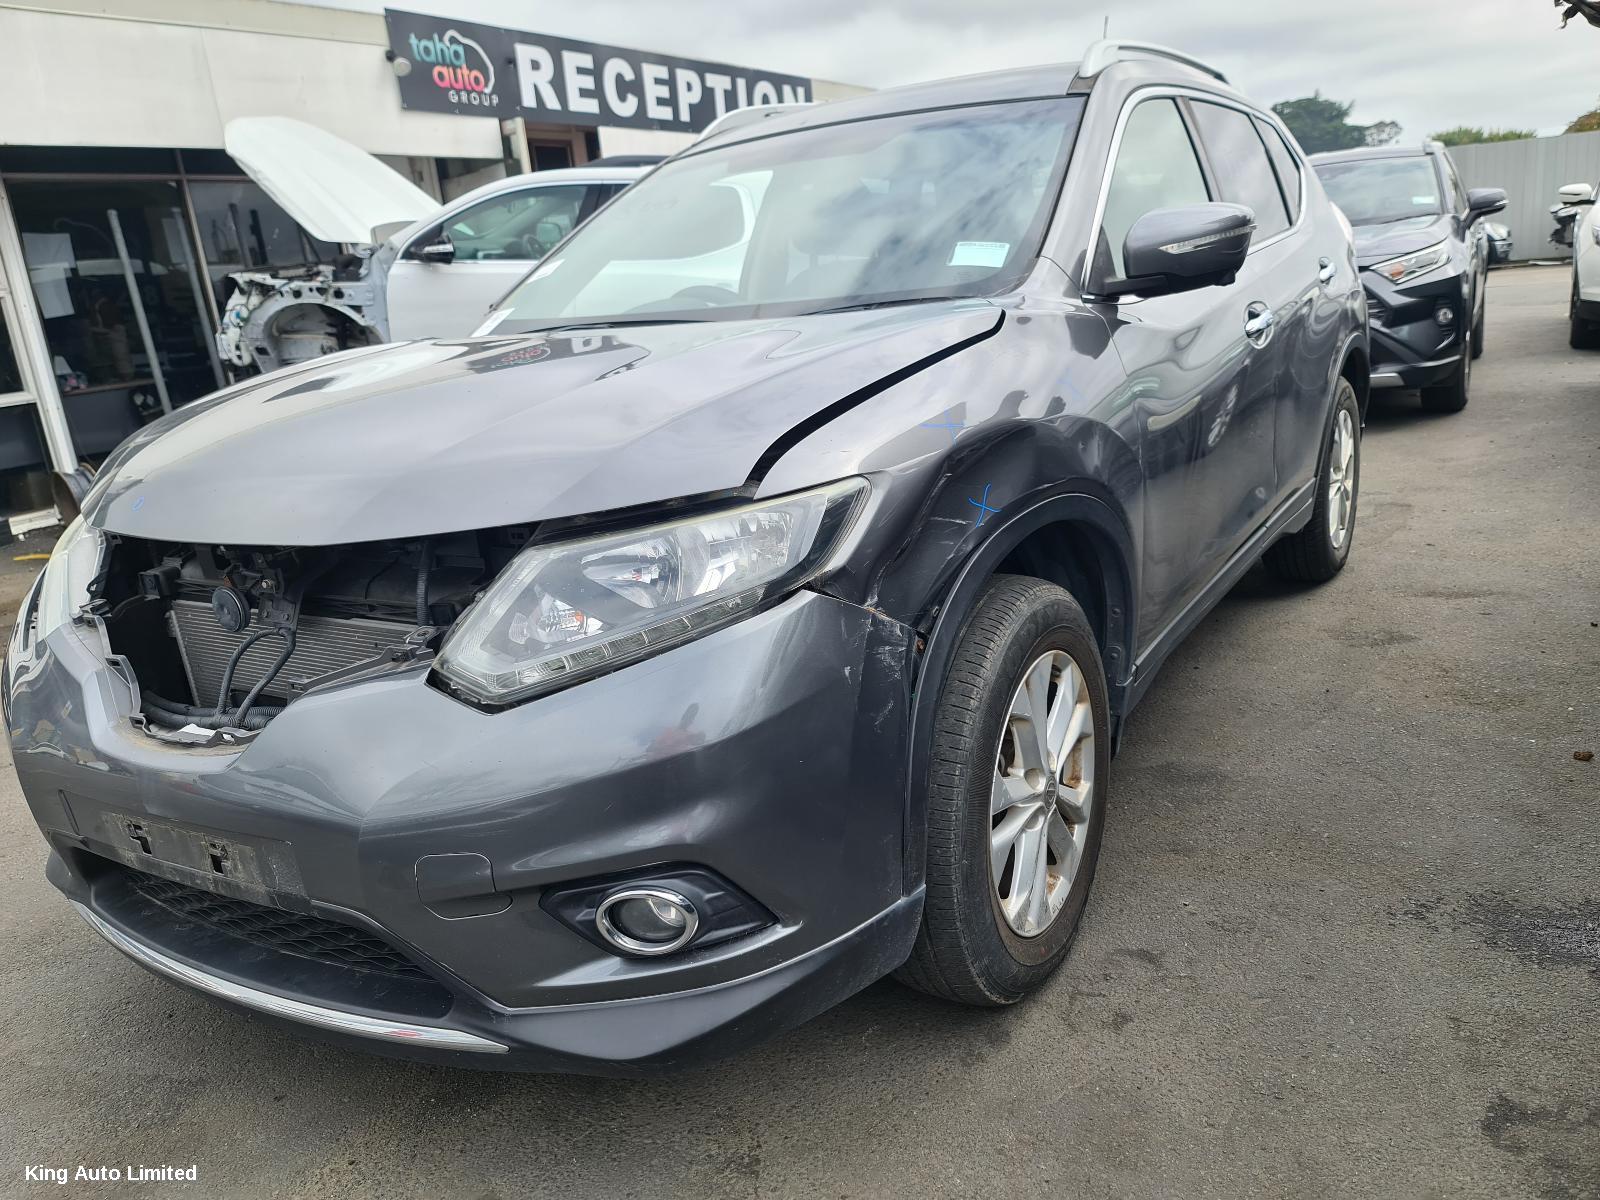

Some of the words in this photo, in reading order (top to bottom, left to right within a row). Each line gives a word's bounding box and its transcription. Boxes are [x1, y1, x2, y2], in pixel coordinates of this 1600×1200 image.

[408, 32, 466, 66] taha
[432, 63, 486, 92] auto
[448, 89, 499, 107] GROUP
